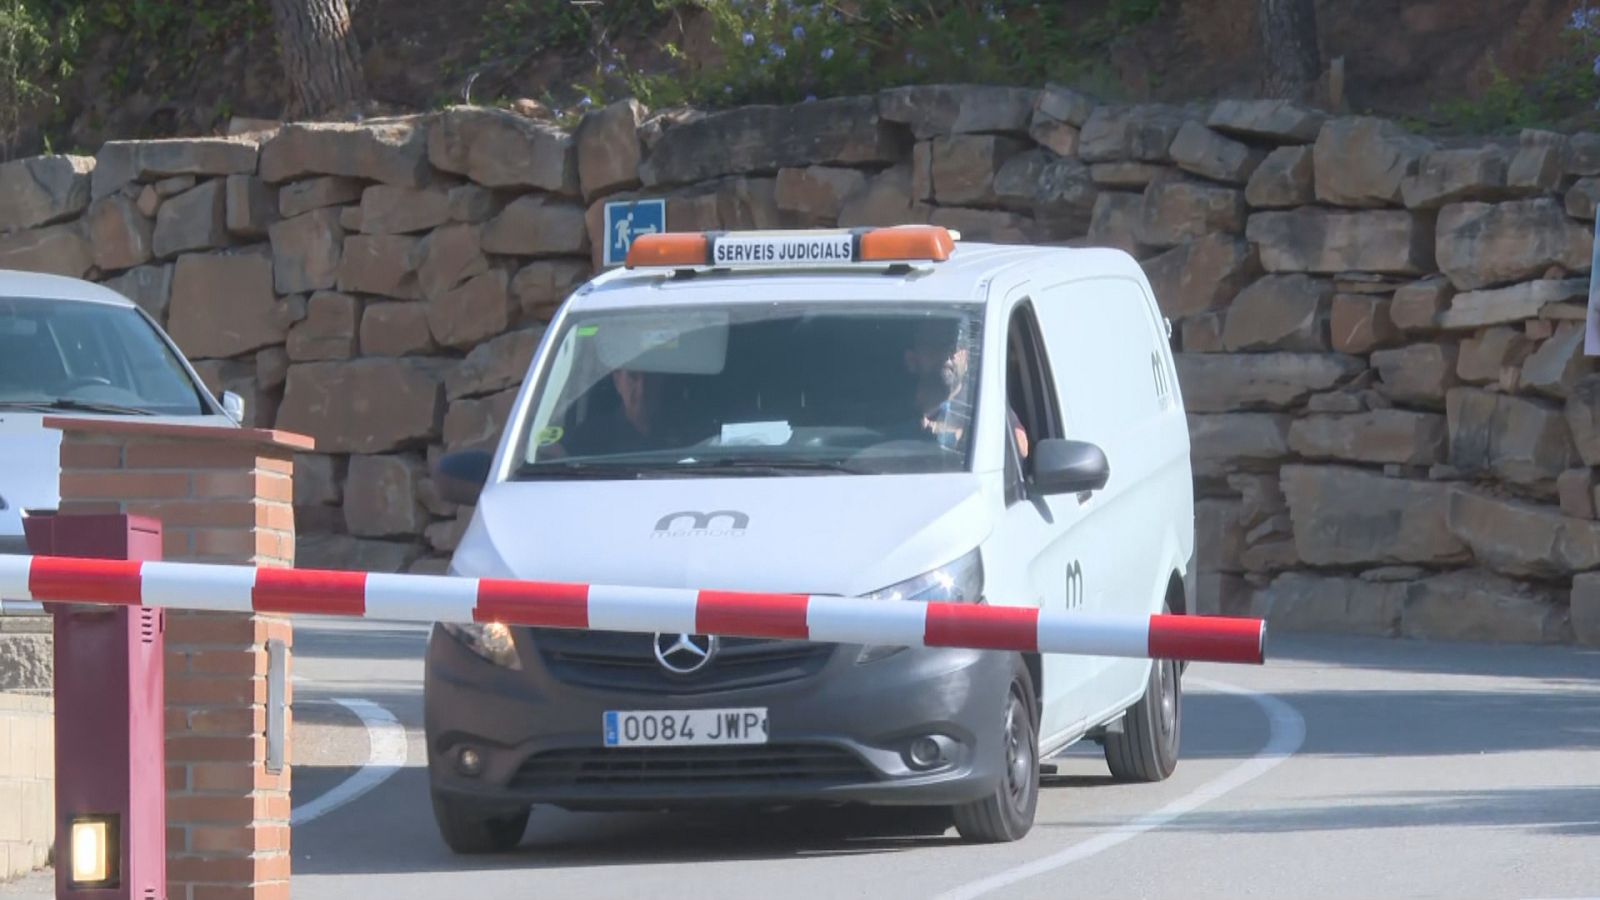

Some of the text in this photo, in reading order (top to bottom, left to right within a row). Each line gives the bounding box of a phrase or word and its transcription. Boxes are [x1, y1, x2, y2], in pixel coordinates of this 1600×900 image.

[717, 242, 851, 261] SERVEIS JUDICIALS
[624, 712, 759, 741] 0084 JWP
